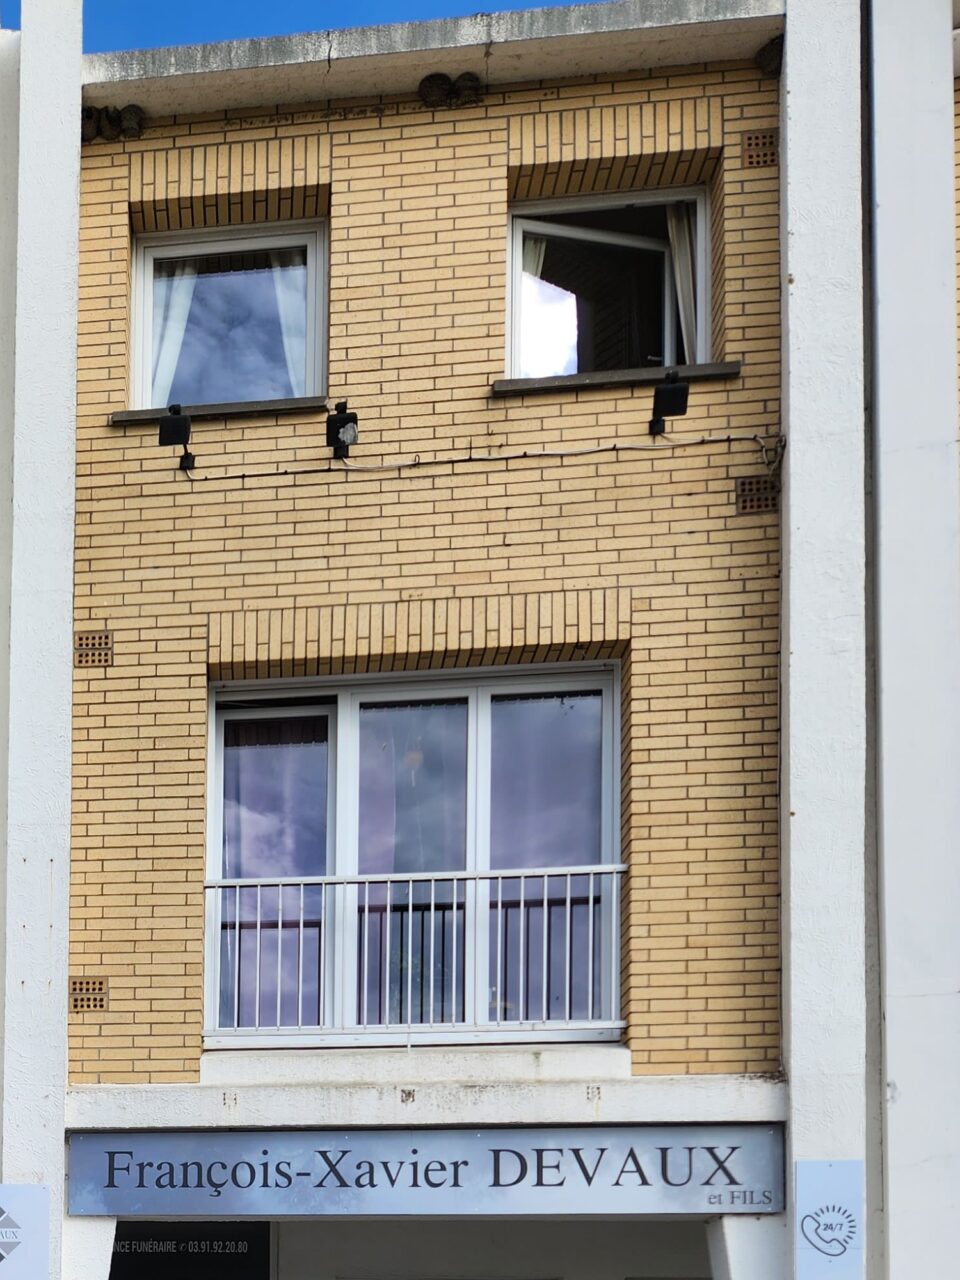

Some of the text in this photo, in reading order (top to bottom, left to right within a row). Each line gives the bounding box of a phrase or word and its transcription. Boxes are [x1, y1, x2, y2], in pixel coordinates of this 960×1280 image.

[103, 1146, 743, 1197] François-Xavier DEVAUX
[707, 1190, 773, 1205] et FILS
[822, 1223, 844, 1232] 24/7
[131, 1238, 176, 1252] FUNÉRAIRE
[188, 1241, 248, 1252] 03.91.92.20.80
